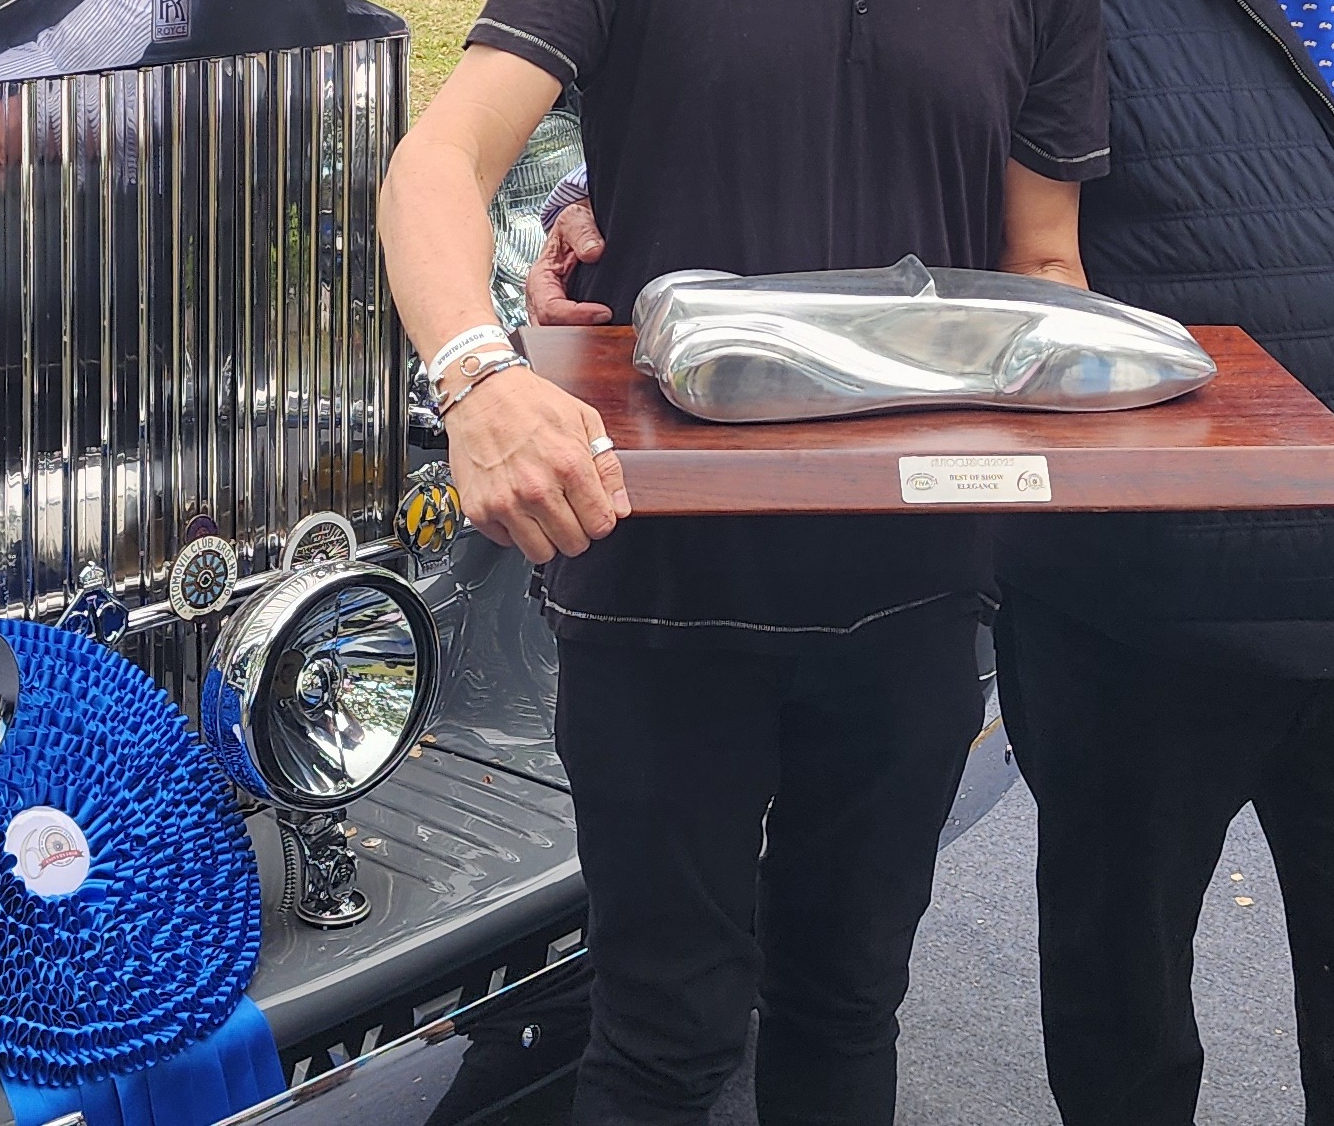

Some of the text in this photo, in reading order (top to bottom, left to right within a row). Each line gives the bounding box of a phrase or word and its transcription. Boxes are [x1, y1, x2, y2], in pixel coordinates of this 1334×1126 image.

[156, 25, 187, 36] ROYCE
[171, 555, 190, 611] AUTOMOVIL
[191, 538, 214, 553] CLUB
[215, 539, 236, 596] ARGENTINO
